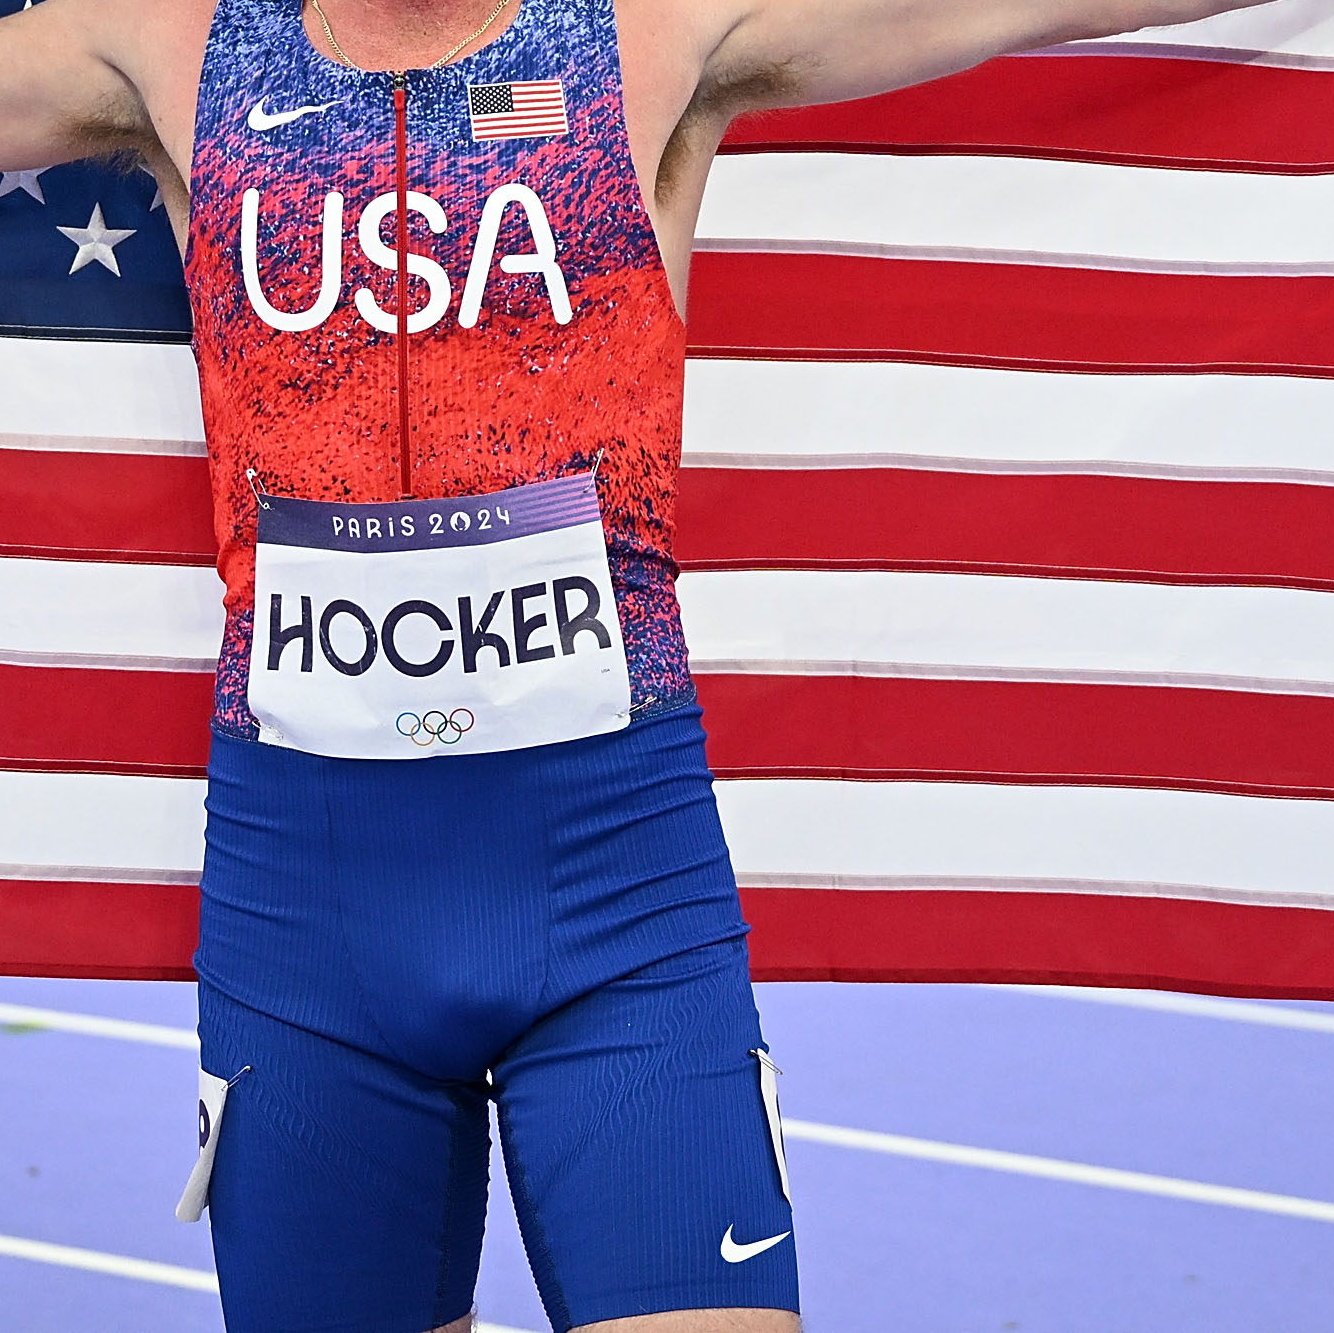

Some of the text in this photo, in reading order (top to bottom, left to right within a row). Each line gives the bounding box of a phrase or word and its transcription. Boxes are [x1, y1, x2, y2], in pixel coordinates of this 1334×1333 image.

[241, 183, 574, 334] USA
[428, 506, 511, 535] 2024
[267, 576, 613, 678] HOCKER
